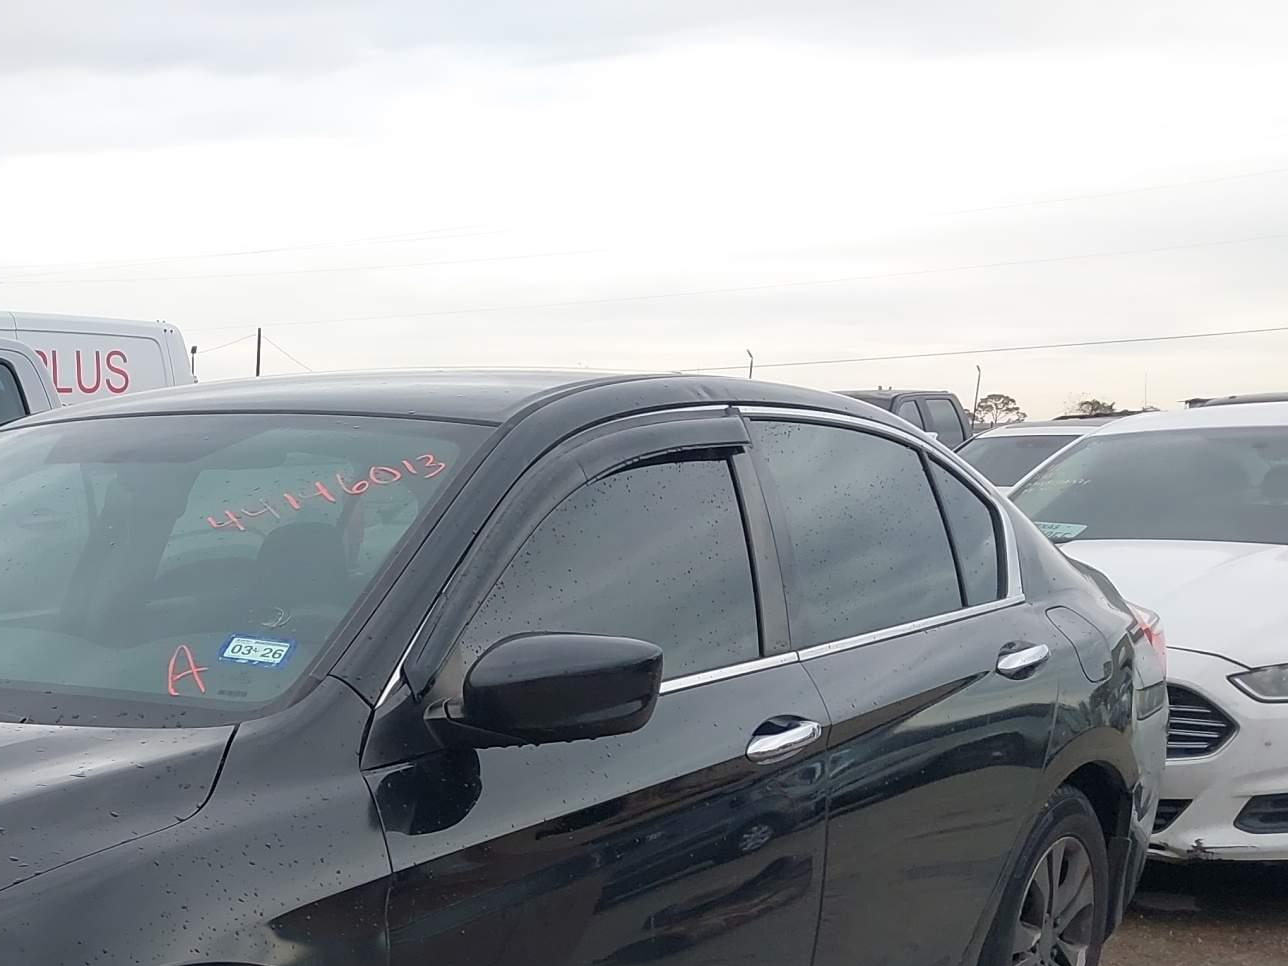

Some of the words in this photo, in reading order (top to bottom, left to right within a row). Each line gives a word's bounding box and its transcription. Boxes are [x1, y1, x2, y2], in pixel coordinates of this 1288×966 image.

[206, 454, 446, 531] 44146013
[167, 644, 209, 697] A
[230, 643, 253, 656] 03
[260, 647, 285, 660] 26
